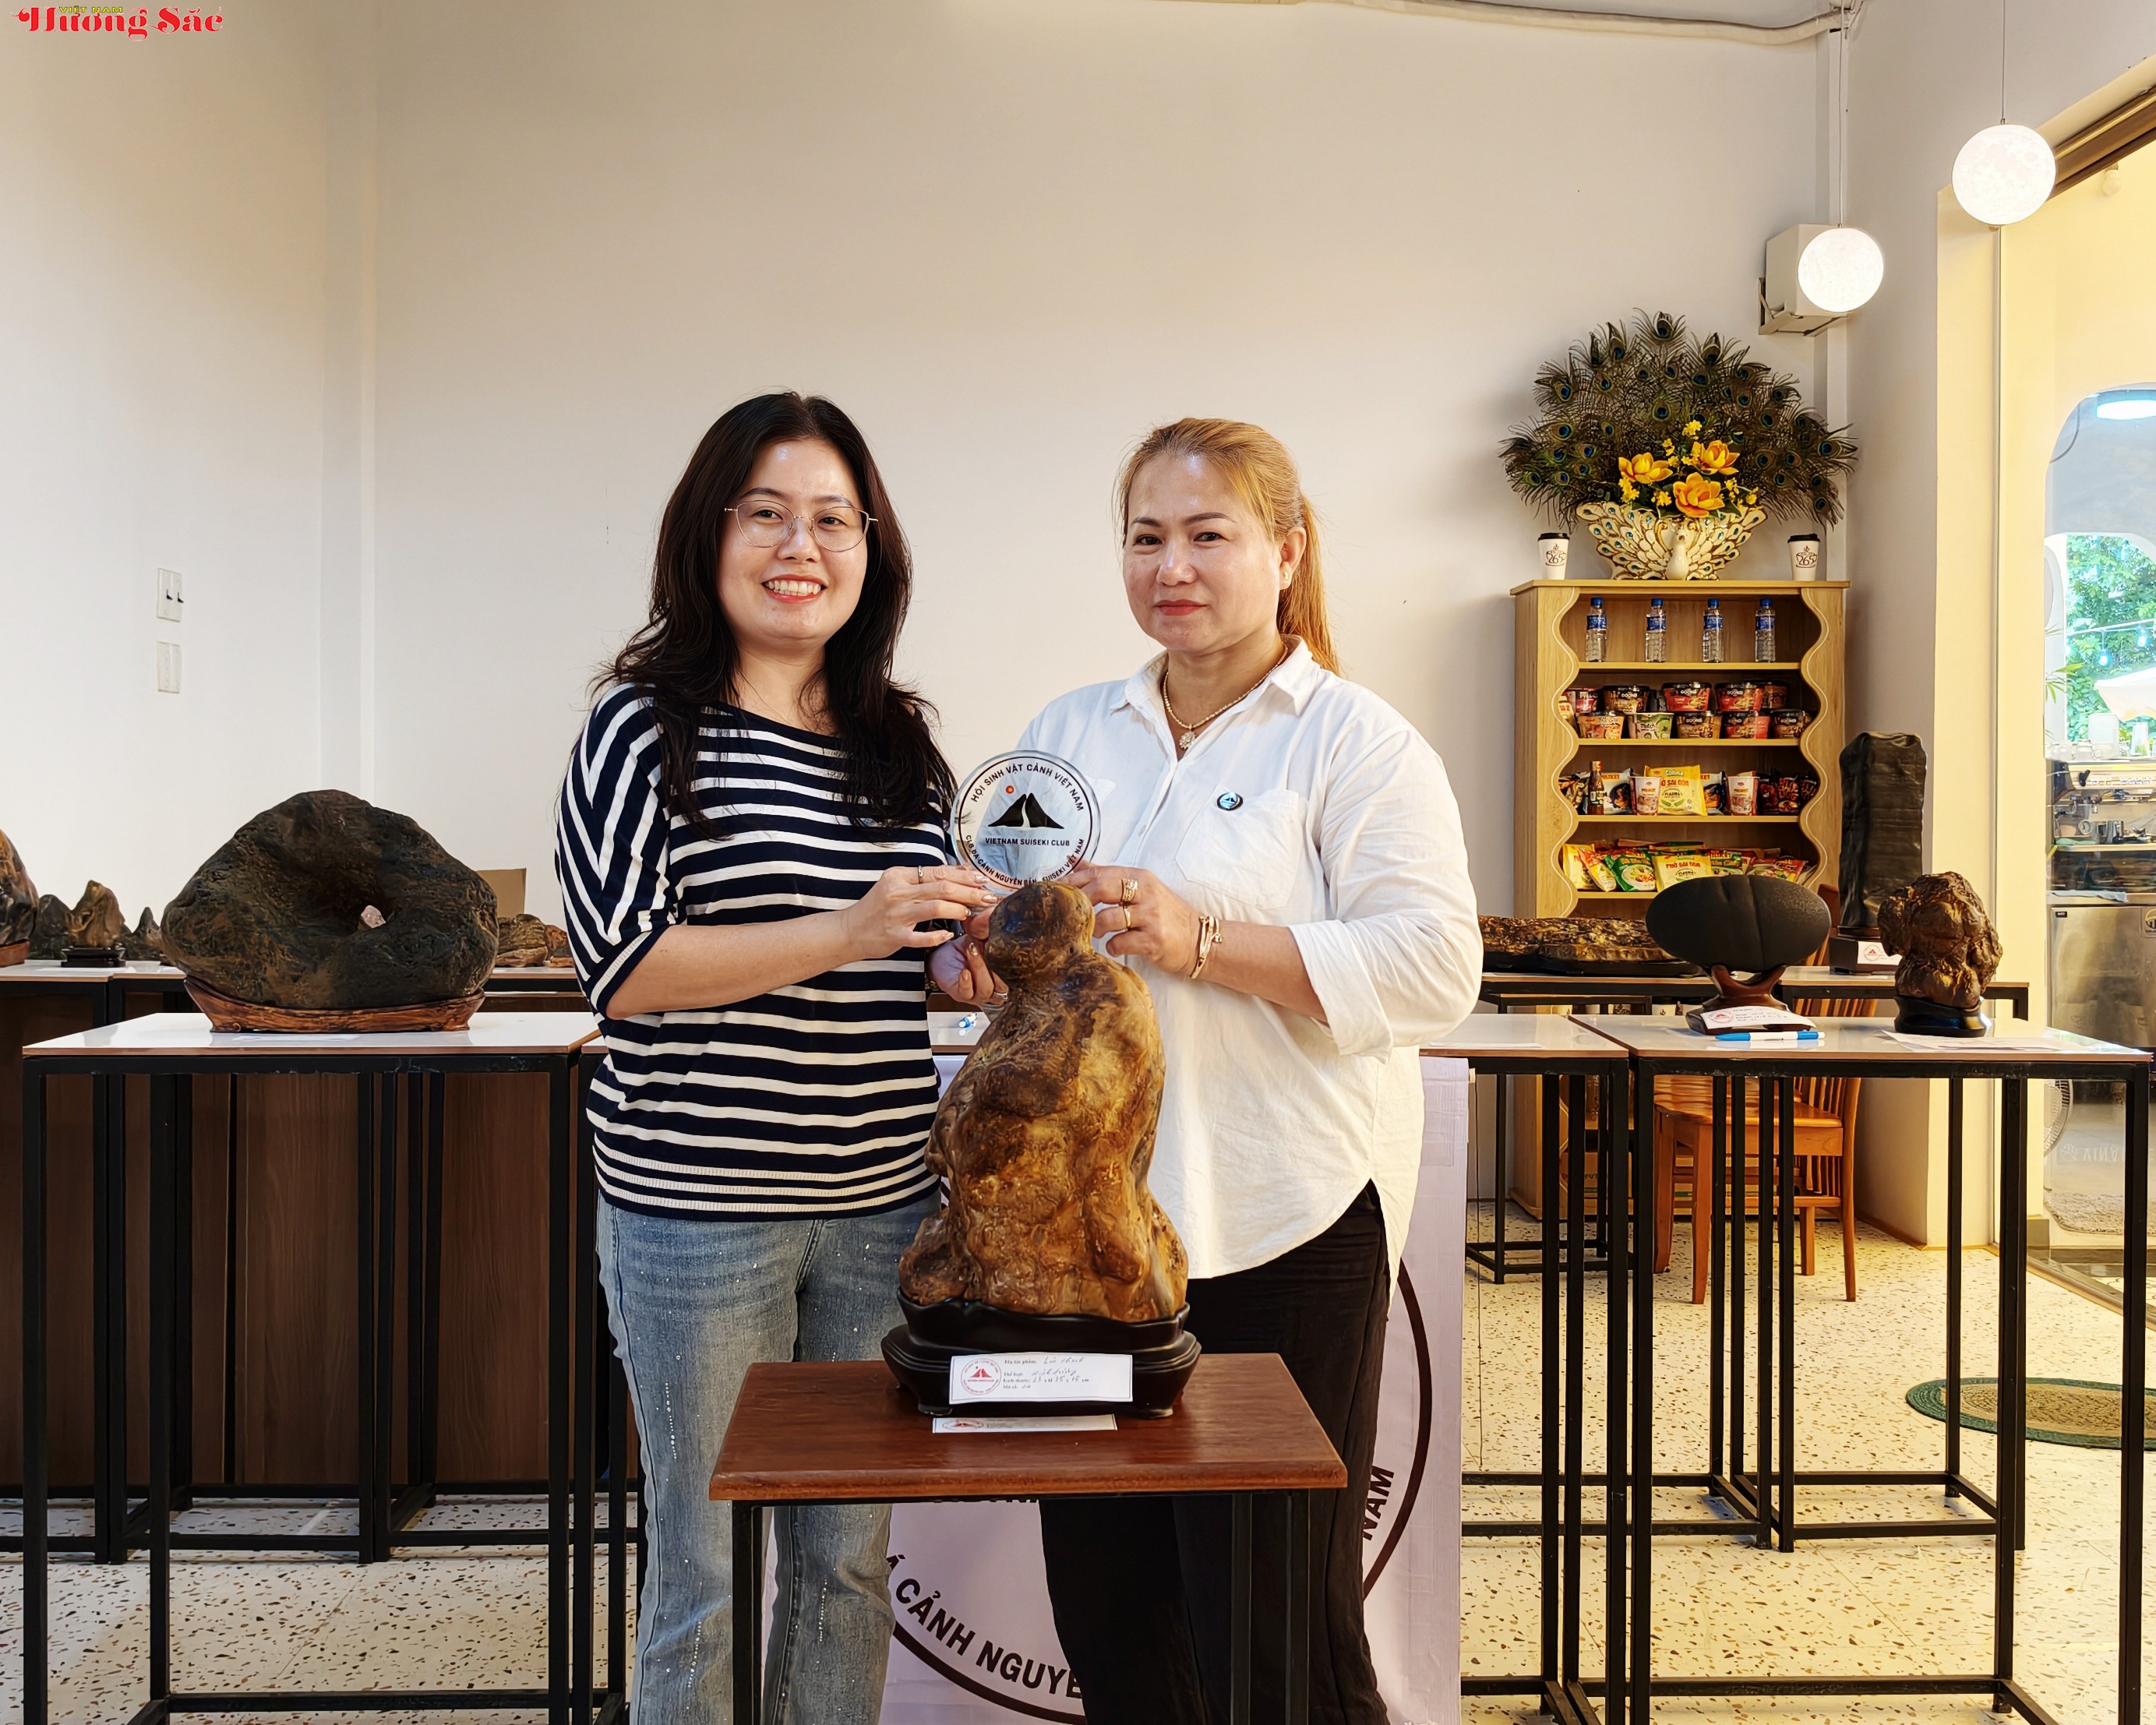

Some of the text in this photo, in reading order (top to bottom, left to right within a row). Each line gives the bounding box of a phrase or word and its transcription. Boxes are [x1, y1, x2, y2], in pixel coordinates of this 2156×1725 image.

[971, 763, 1084, 811] HỘI SINH VẬT CẢNH VIỆT NAM
[985, 837, 1018, 845] VIETNAM
[1074, 838, 1084, 855] NAM
[896, 1578, 976, 1656] CẢNH
